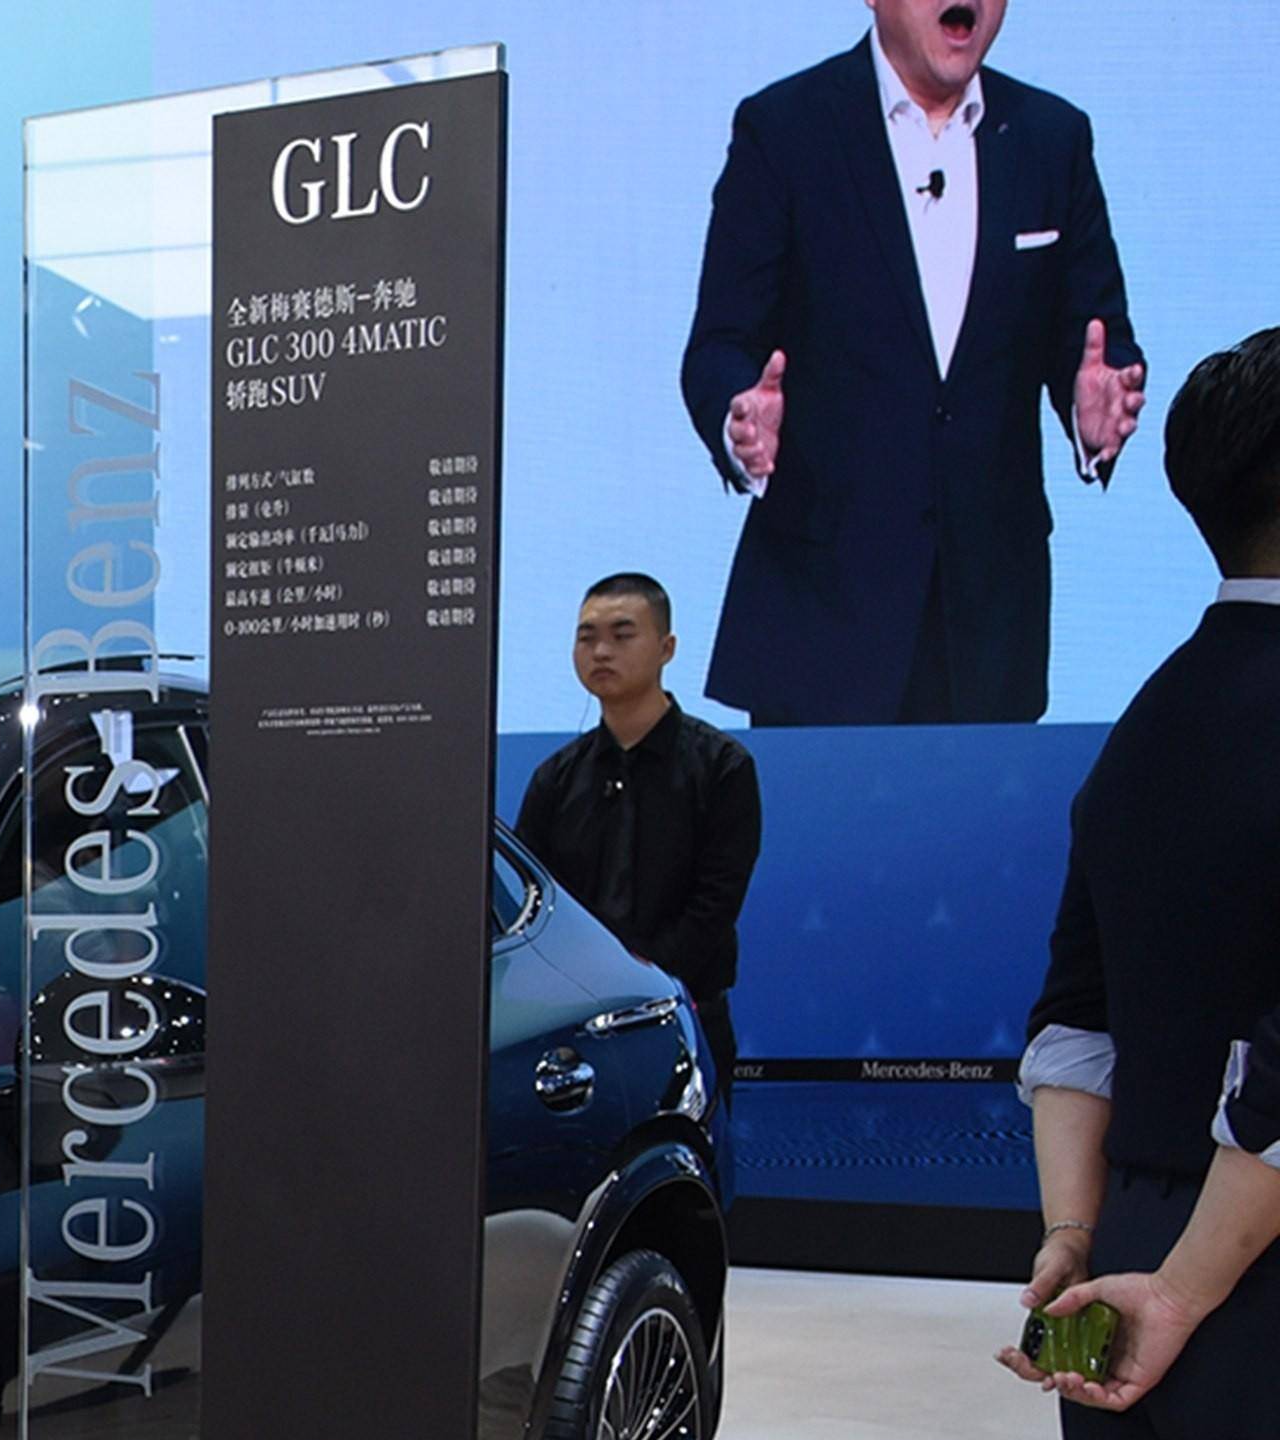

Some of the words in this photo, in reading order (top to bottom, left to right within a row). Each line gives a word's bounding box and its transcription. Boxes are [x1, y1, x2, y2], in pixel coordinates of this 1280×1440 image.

[271, 121, 431, 225] GLC
[225, 335, 279, 369] GLC
[285, 329, 335, 362] 300
[341, 315, 447, 355] 4MATIC
[226, 373, 327, 411] 轿跑SUV
[860, 1060, 993, 1079] Mercedes-Benz
